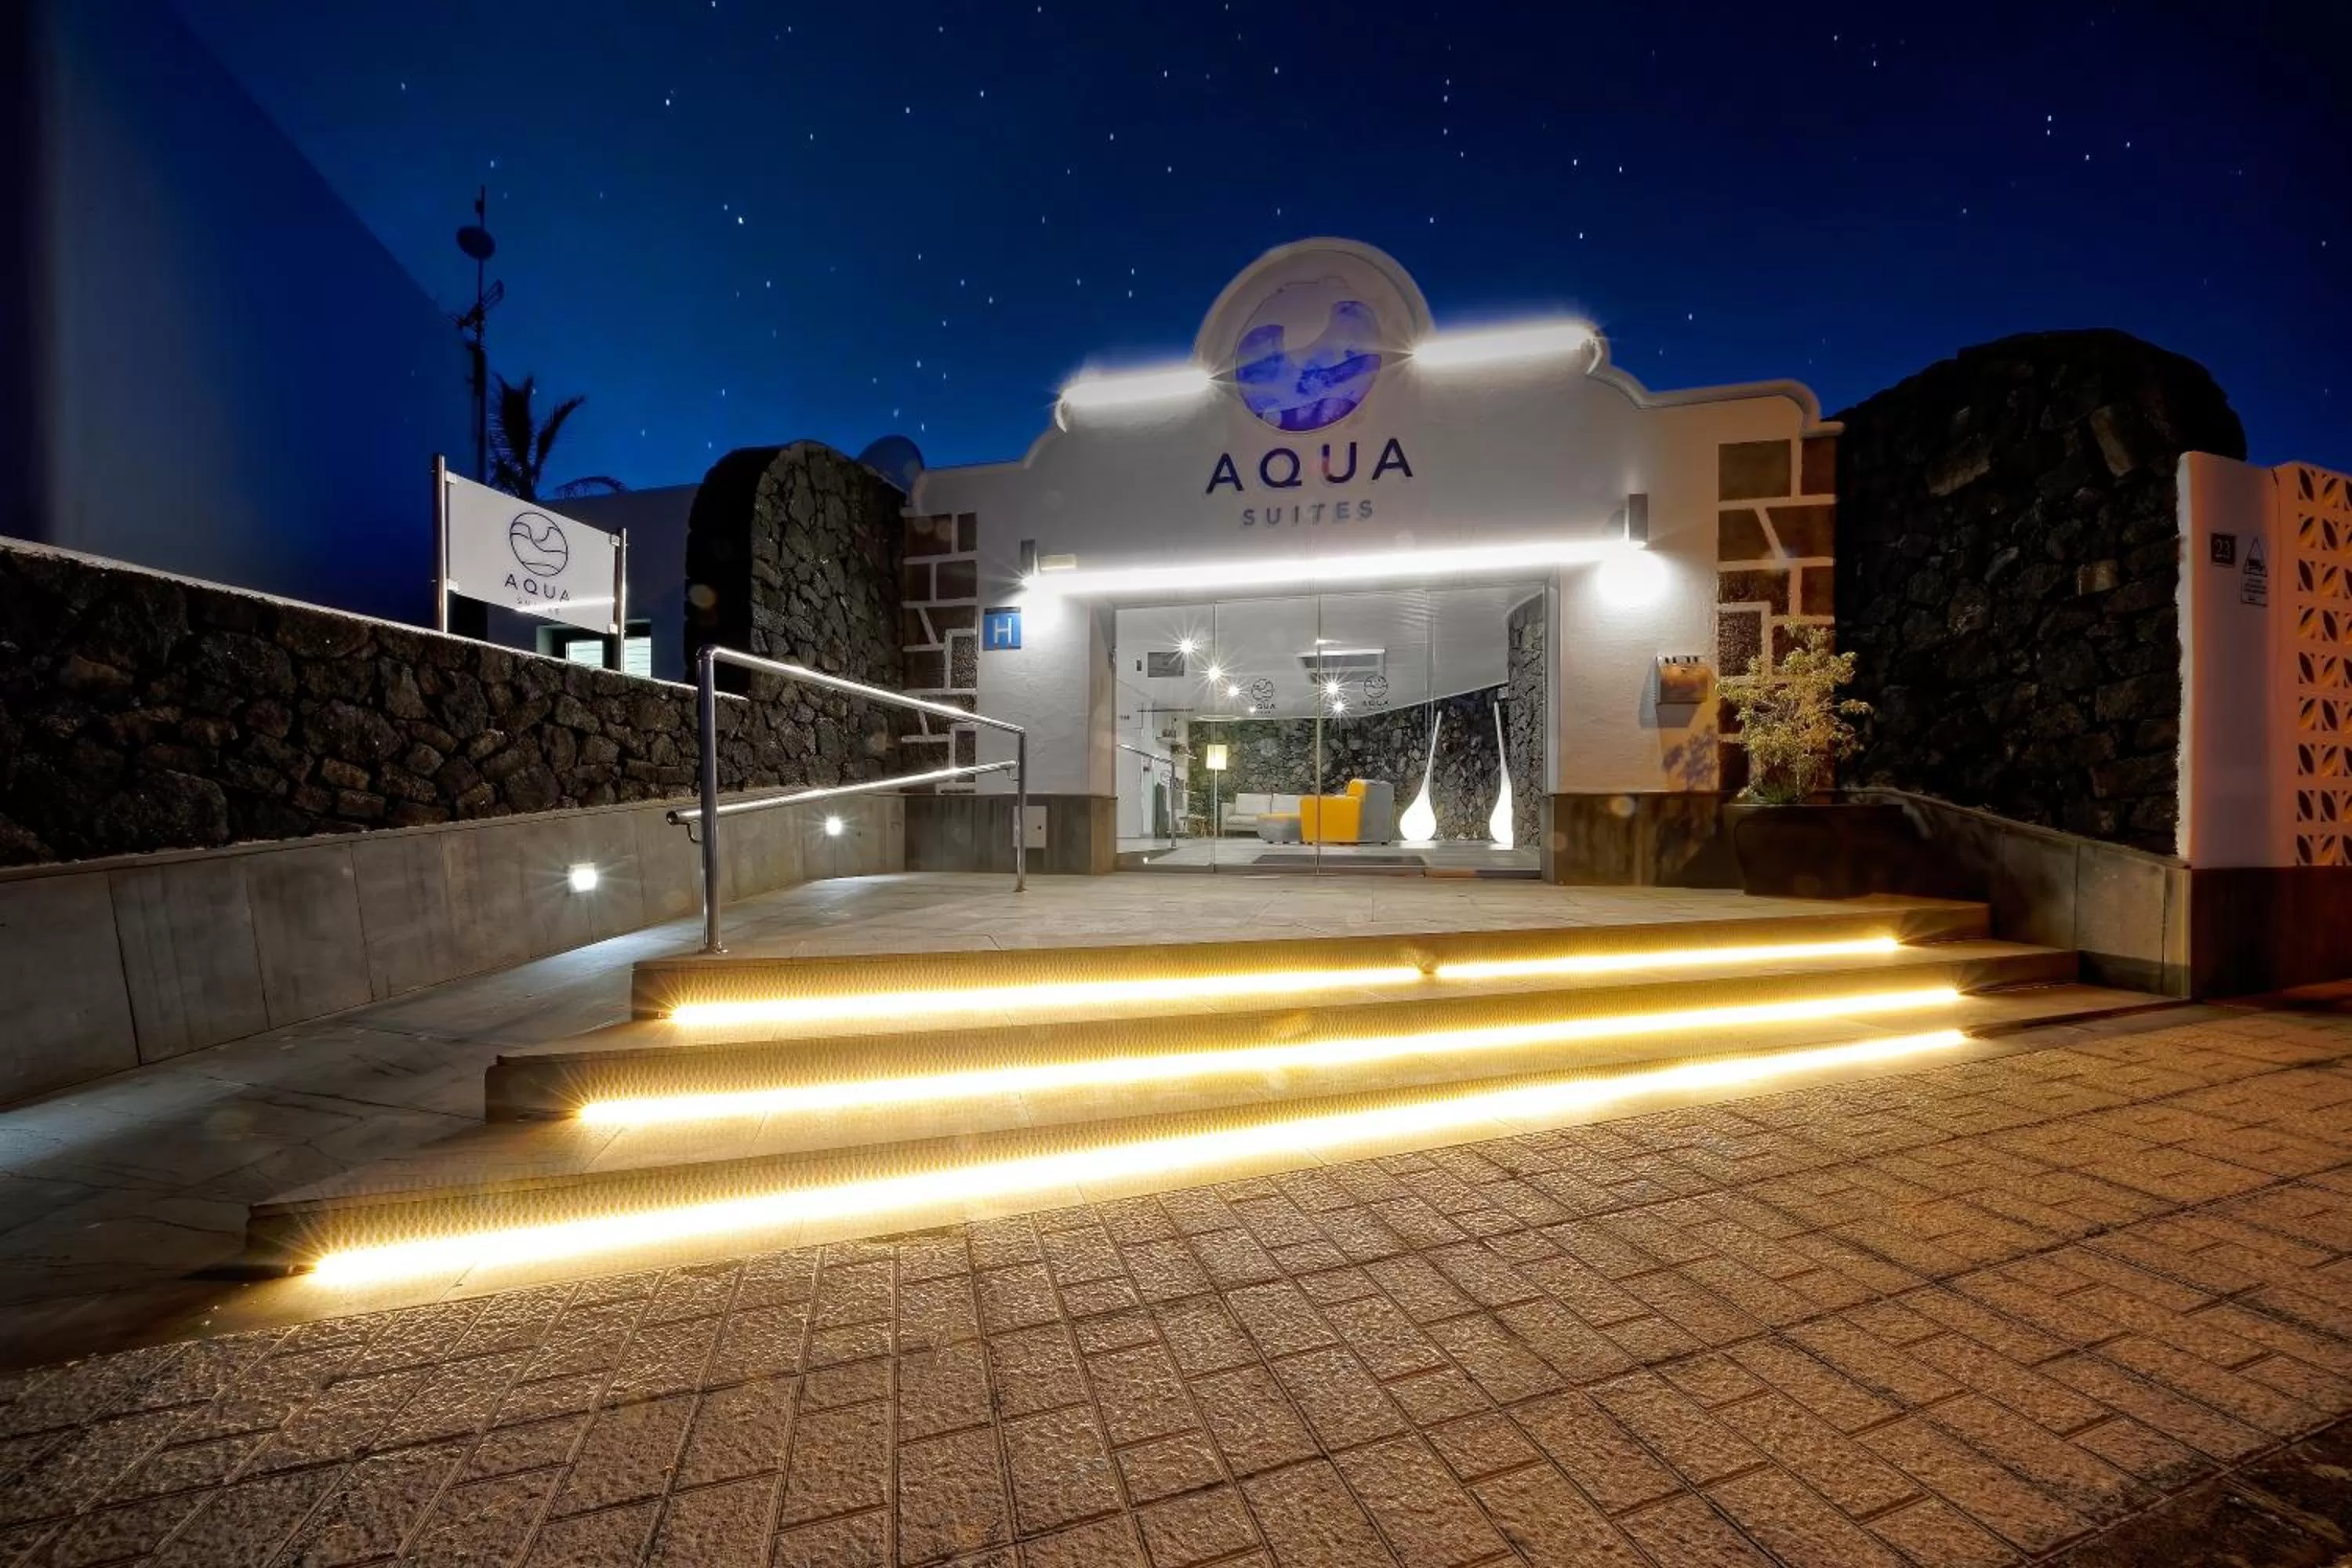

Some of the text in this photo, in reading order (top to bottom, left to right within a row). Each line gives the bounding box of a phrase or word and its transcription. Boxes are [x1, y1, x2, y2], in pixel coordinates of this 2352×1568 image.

[1206, 437, 1413, 494] AQUA
[1242, 499, 1374, 526] SUITES
[504, 574, 570, 602] AQUA
[994, 617, 1012, 643] H
